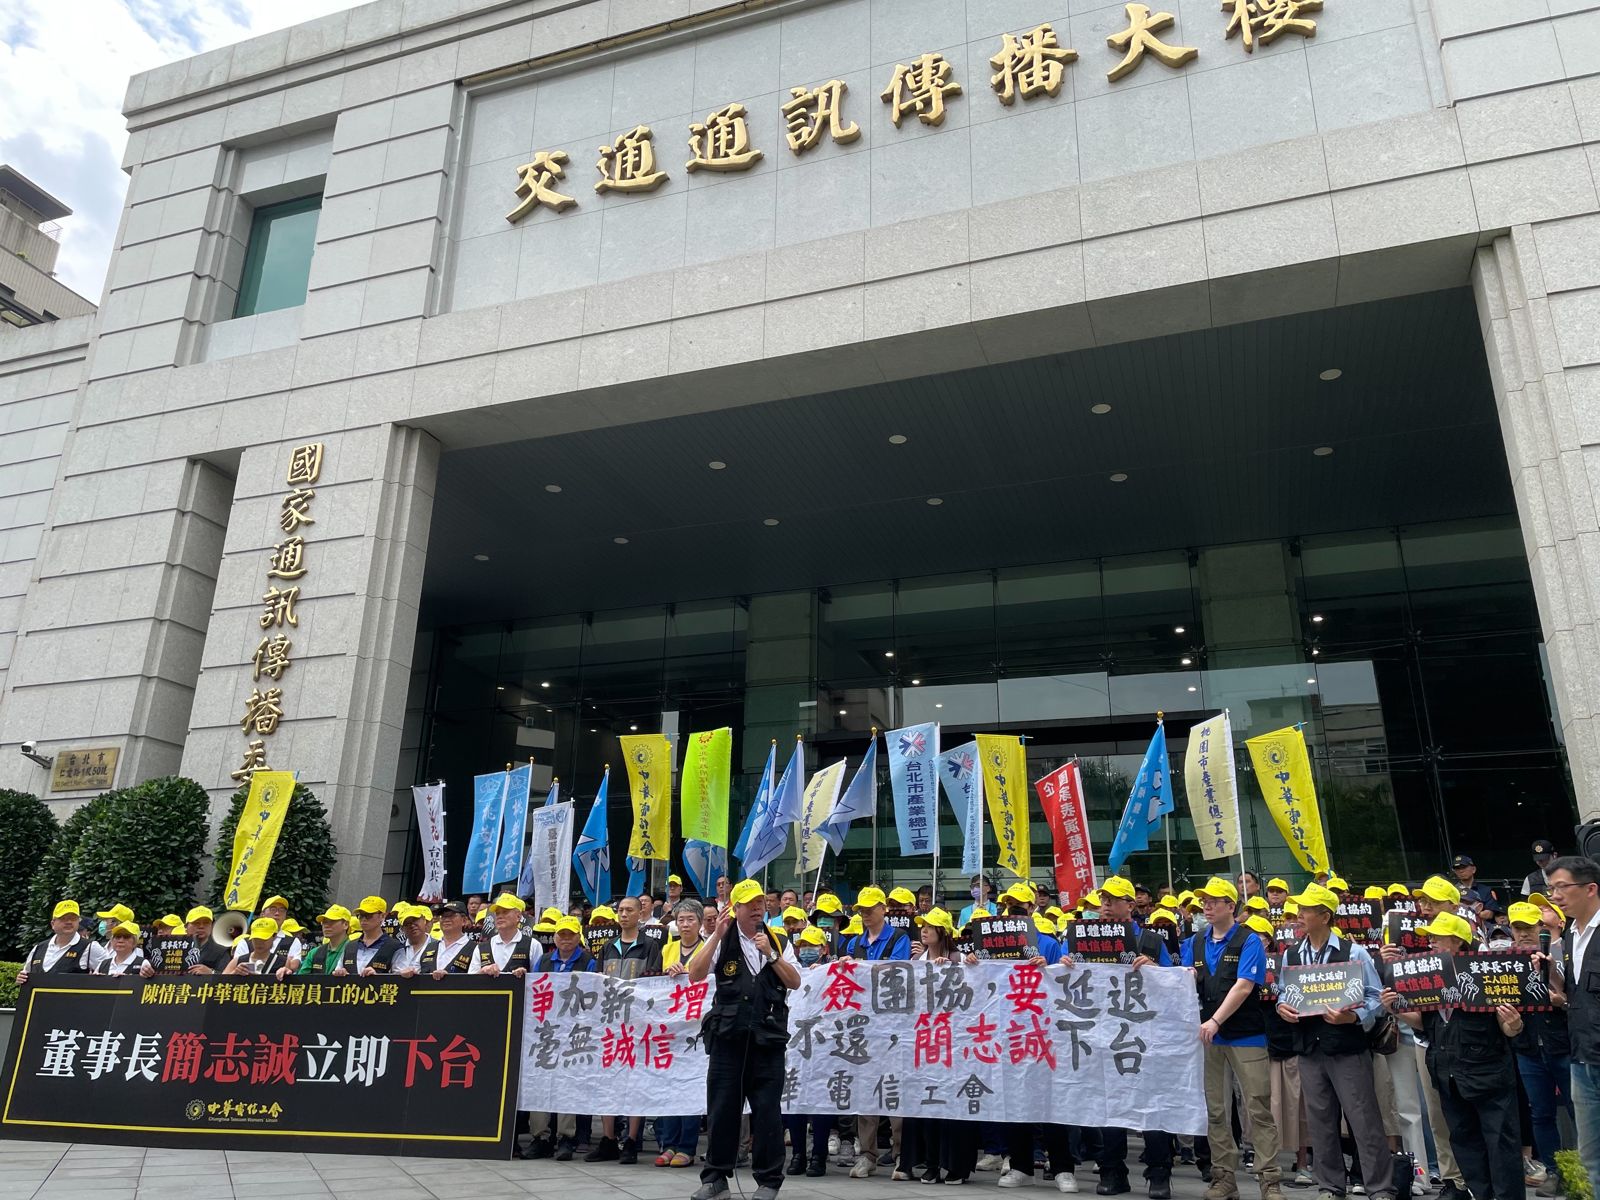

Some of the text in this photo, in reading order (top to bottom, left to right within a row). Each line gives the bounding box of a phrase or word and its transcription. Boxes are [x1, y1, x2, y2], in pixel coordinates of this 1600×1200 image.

[905, 761, 929, 850] 台北市產業總工會
[981, 917, 1028, 934] 團體協約
[1075, 922, 1126, 938] 團體協約
[1393, 956, 1443, 977] 團體協約
[1483, 974, 1519, 984] 工人團結
[141, 983, 399, 1006] 陳情書-中華電信基層員工的心聲
[35, 1029, 483, 1088] 董事長簡志誠立即下台
[207, 1099, 283, 1118] 中華電信工會
